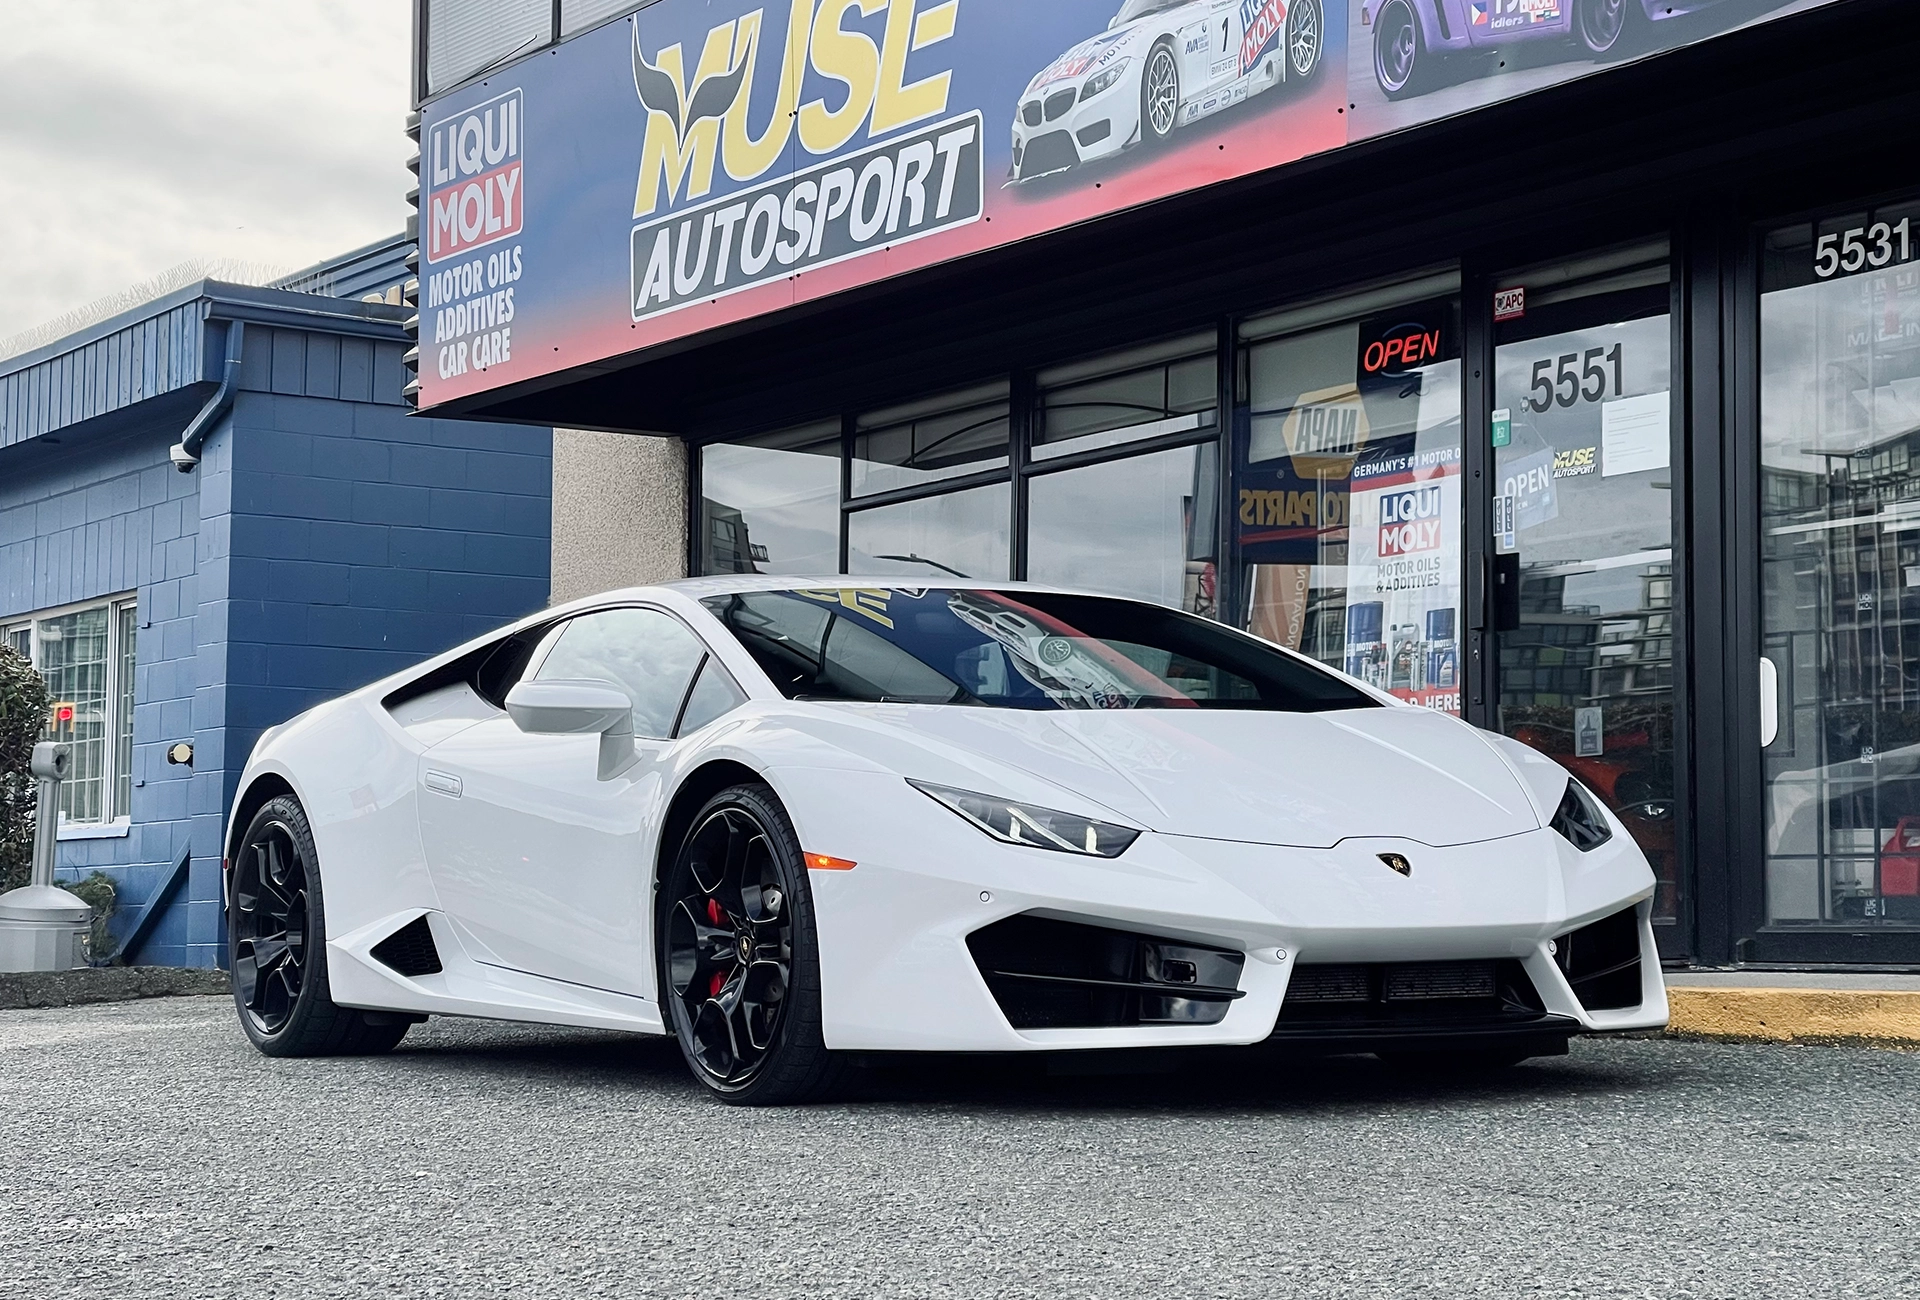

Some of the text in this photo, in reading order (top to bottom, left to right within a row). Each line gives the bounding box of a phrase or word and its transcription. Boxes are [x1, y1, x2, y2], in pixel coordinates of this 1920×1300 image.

[1222, 17, 1228, 52] 1
[1246, 0, 1281, 62] MOLY
[1491, 16, 1524, 28] idlers
[633, 0, 959, 219] MUSE
[433, 98, 517, 187] LIQUI
[433, 167, 520, 254] MOLY
[635, 124, 976, 310] AUTOSPORT
[1814, 217, 1910, 277] 5531
[428, 259, 483, 308] MOTOR
[487, 245, 522, 289] OILS
[435, 287, 515, 344] ADDITIVES
[1505, 292, 1523, 309] APC
[438, 327, 511, 380] CAR CARE
[1364, 330, 1440, 372] OPEN
[1529, 342, 1623, 414] 5551
[1353, 457, 1405, 478] GERMANY'S
[1407, 456, 1419, 468] #1
[1421, 448, 1453, 466] MOTOR
[1553, 447, 1597, 469] MUSE
[1553, 463, 1597, 479] AUTOSPORT
[1504, 464, 1549, 498] OPEN
[1382, 488, 1439, 525] LIQUI
[1381, 520, 1440, 556] MOLY
[1376, 572, 1440, 593] & ADDITIVES
[1377, 556, 1441, 578] MOTOR OILS
[1425, 692, 1460, 712] HERE
